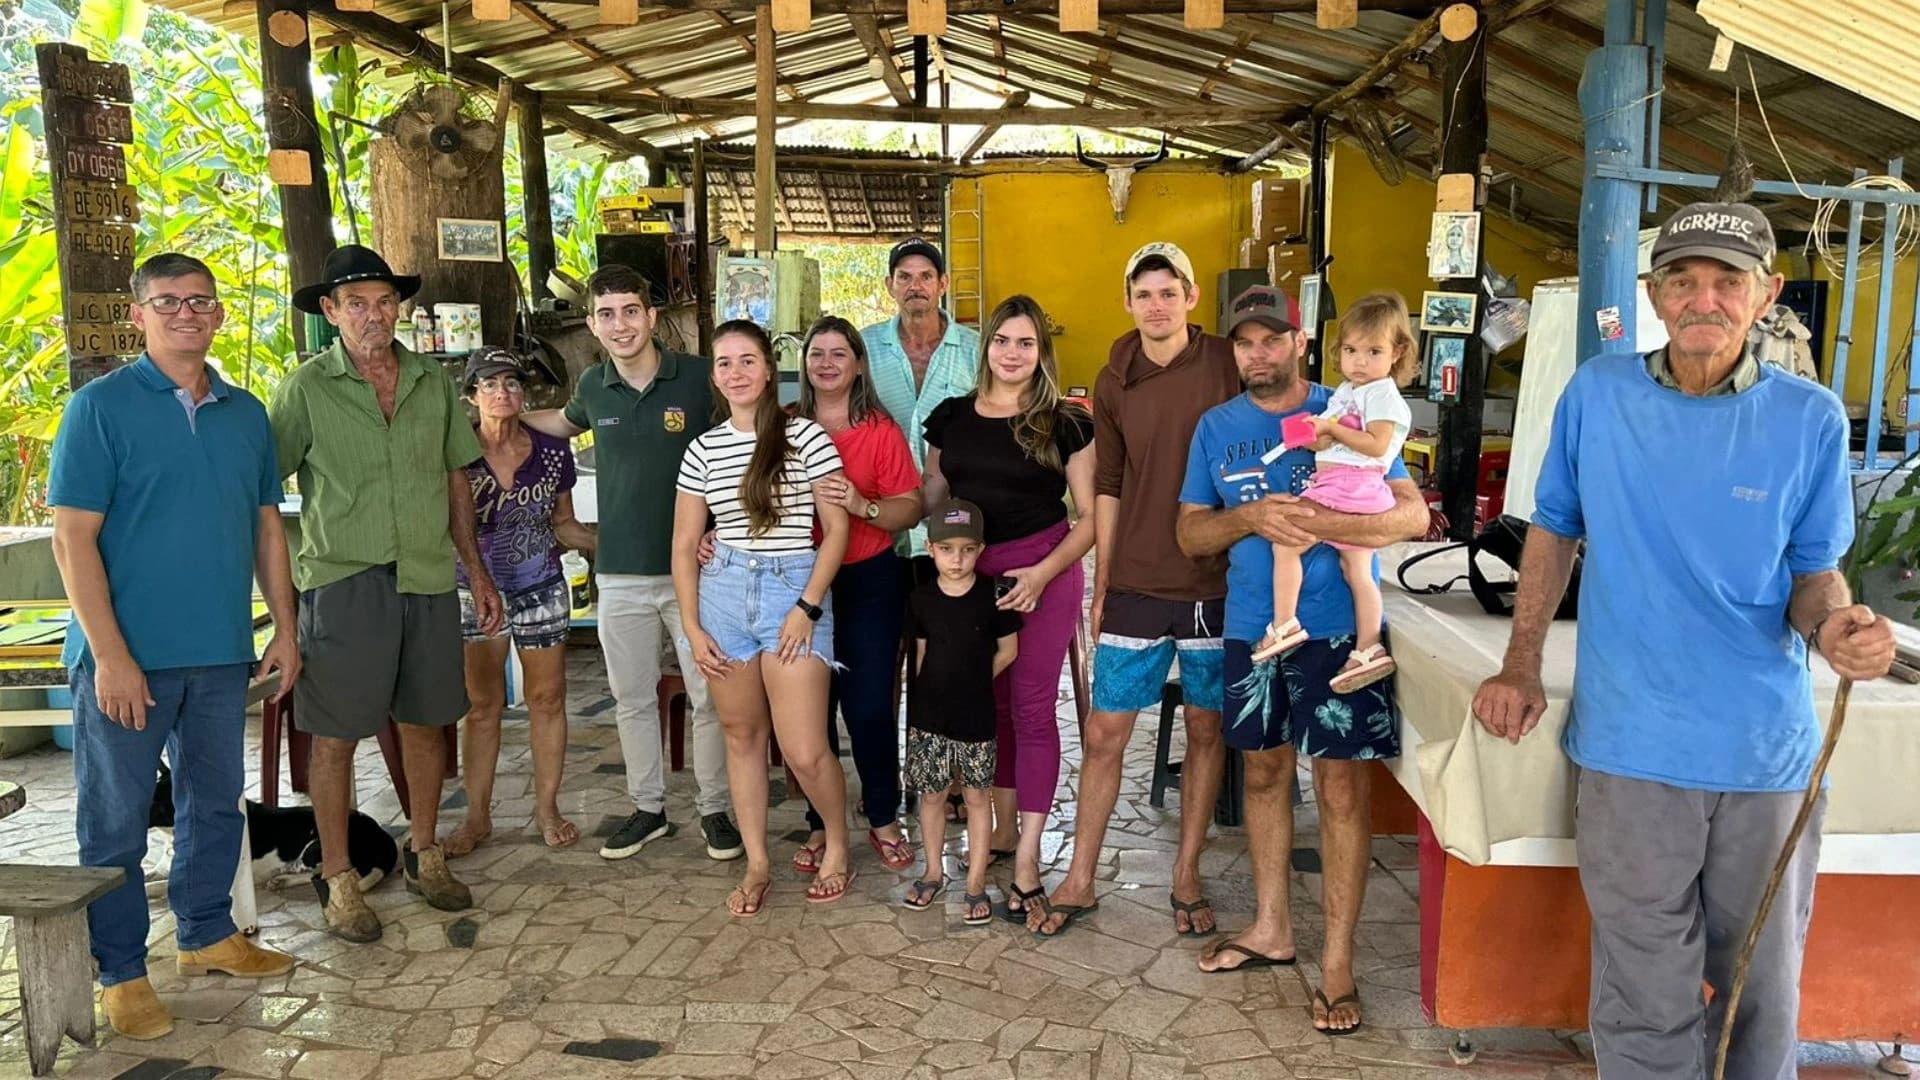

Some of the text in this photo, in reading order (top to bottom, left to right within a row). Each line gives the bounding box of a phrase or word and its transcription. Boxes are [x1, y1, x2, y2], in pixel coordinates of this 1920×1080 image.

[67, 151, 86, 173] DY
[74, 191, 132, 217] BE 9916
[76, 303, 130, 320] JC 187
[76, 334, 146, 351] JC 1874
[1225, 437, 1273, 464] SELV
